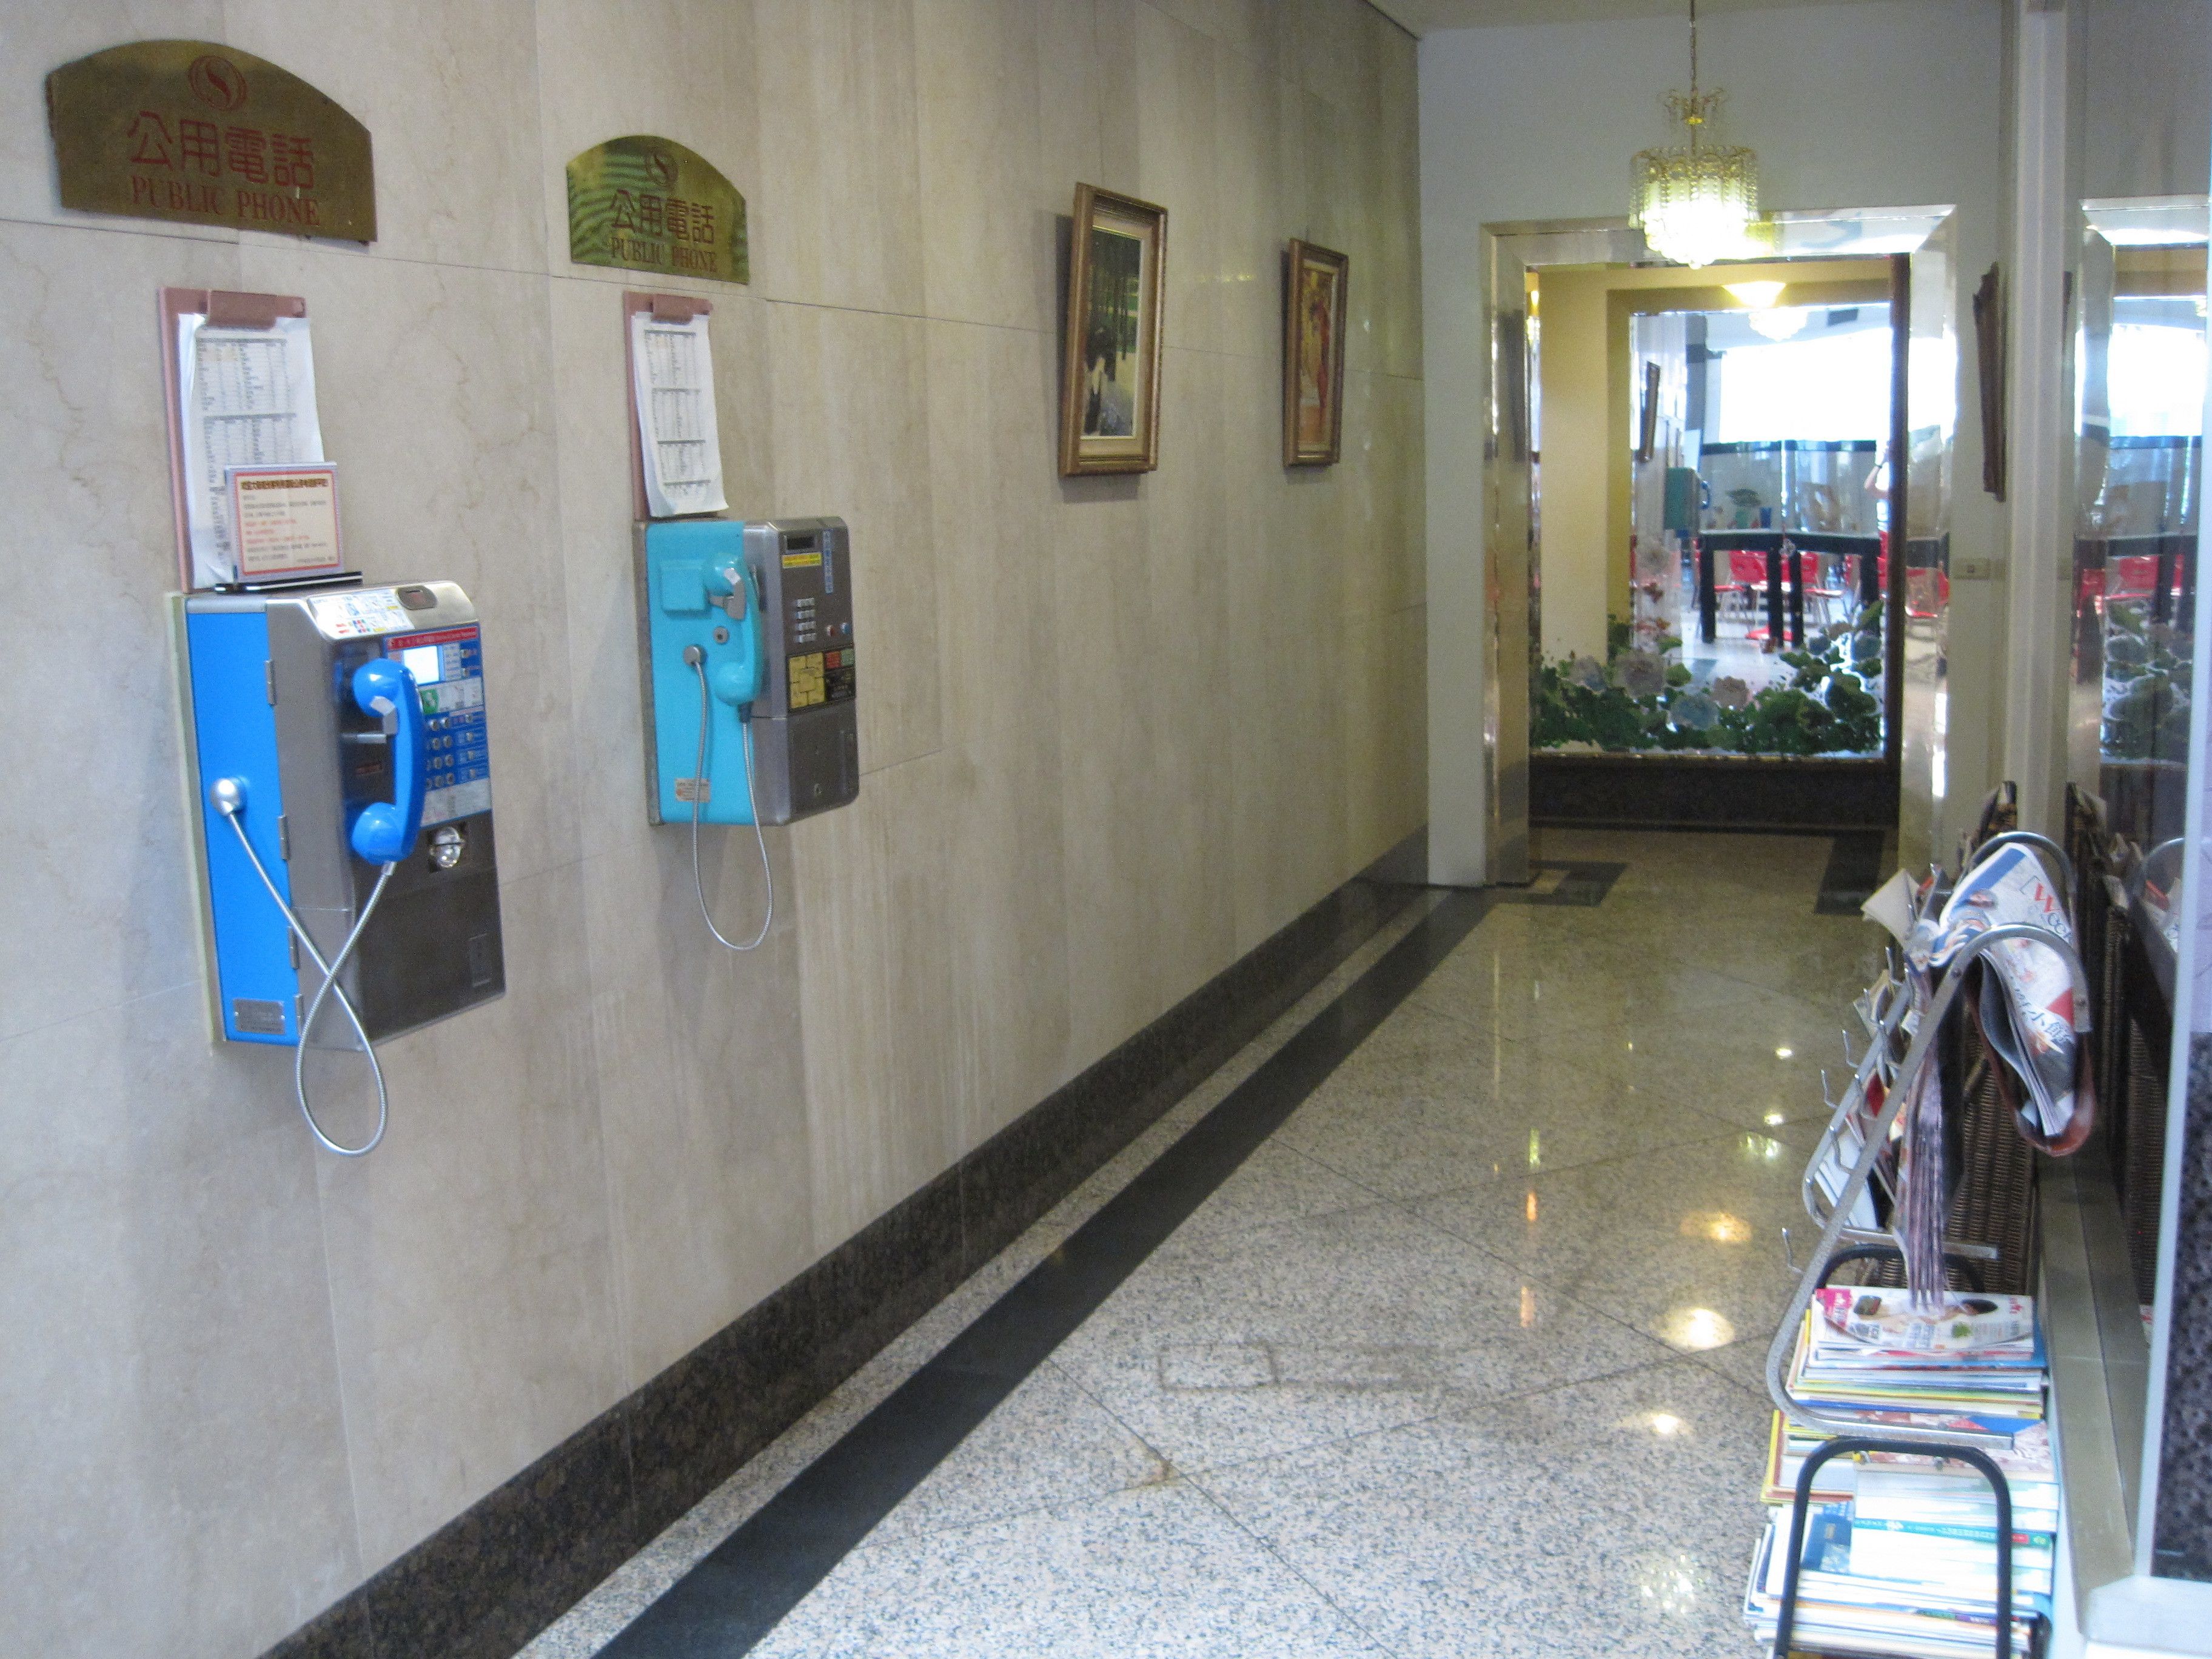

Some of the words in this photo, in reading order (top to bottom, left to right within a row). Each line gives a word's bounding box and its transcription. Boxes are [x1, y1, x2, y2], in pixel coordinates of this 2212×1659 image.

[126, 110, 315, 190] 公用電話
[131, 174, 223, 216] PUBLIC
[238, 189, 321, 227] PHONE
[608, 188, 716, 244] 公用電話
[611, 236, 663, 265] PUBLIC
[672, 246, 717, 273] PHONE
